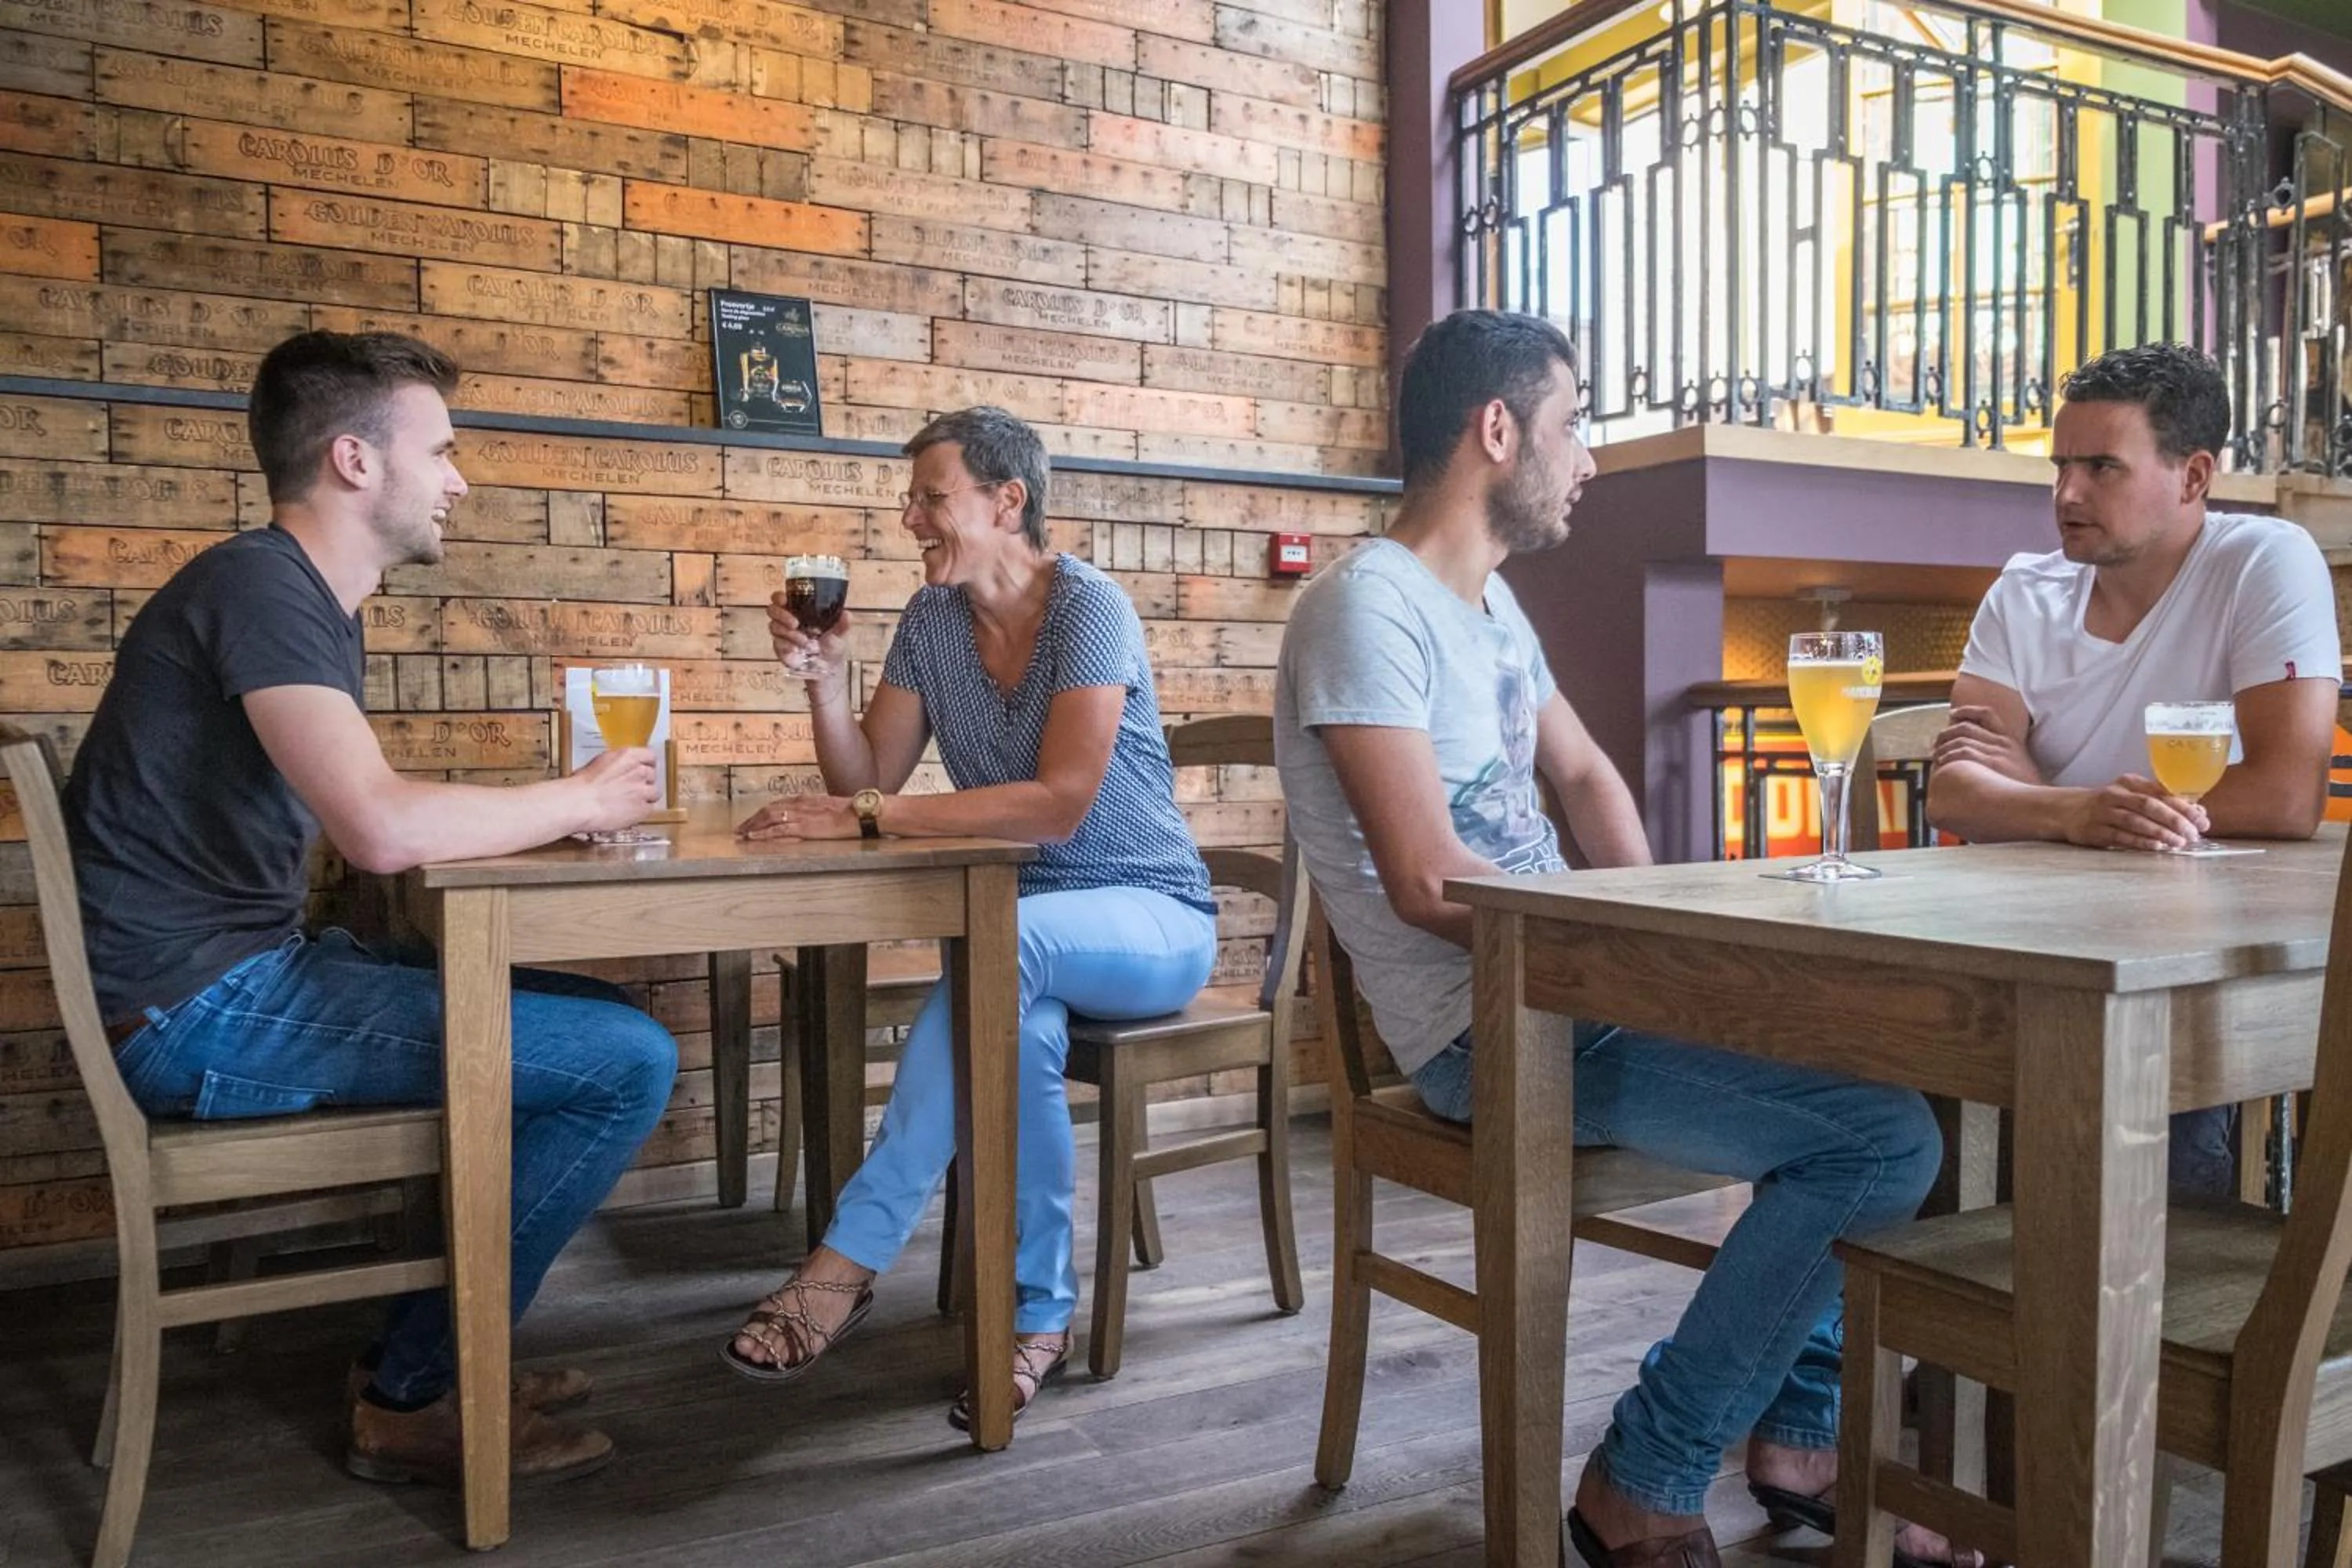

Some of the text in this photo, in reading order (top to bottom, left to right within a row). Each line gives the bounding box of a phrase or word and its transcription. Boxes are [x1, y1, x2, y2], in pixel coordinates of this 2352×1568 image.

[506, 34, 602, 59] MECHELEN
[238, 132, 358, 172] CAROLUS
[292, 166, 401, 190] MECHELEN
[303, 200, 539, 249] GOUDEN CAROLUS
[370, 230, 475, 253] MECHELEN
[1001, 287, 1086, 314] CAROLUS
[1036, 312, 1111, 330] MECHELEN
[146, 354, 253, 381] GOUDE
[1001, 354, 1076, 370] MECHELEN
[477, 440, 702, 474] GOUDEN CAROLUS
[542, 468, 641, 485] MECHELEN
[766, 456, 864, 485] CAROLUS
[808, 483, 897, 499] MECHELEN
[433, 719, 512, 749] D'OR
[686, 743, 778, 754] MECHELEN
